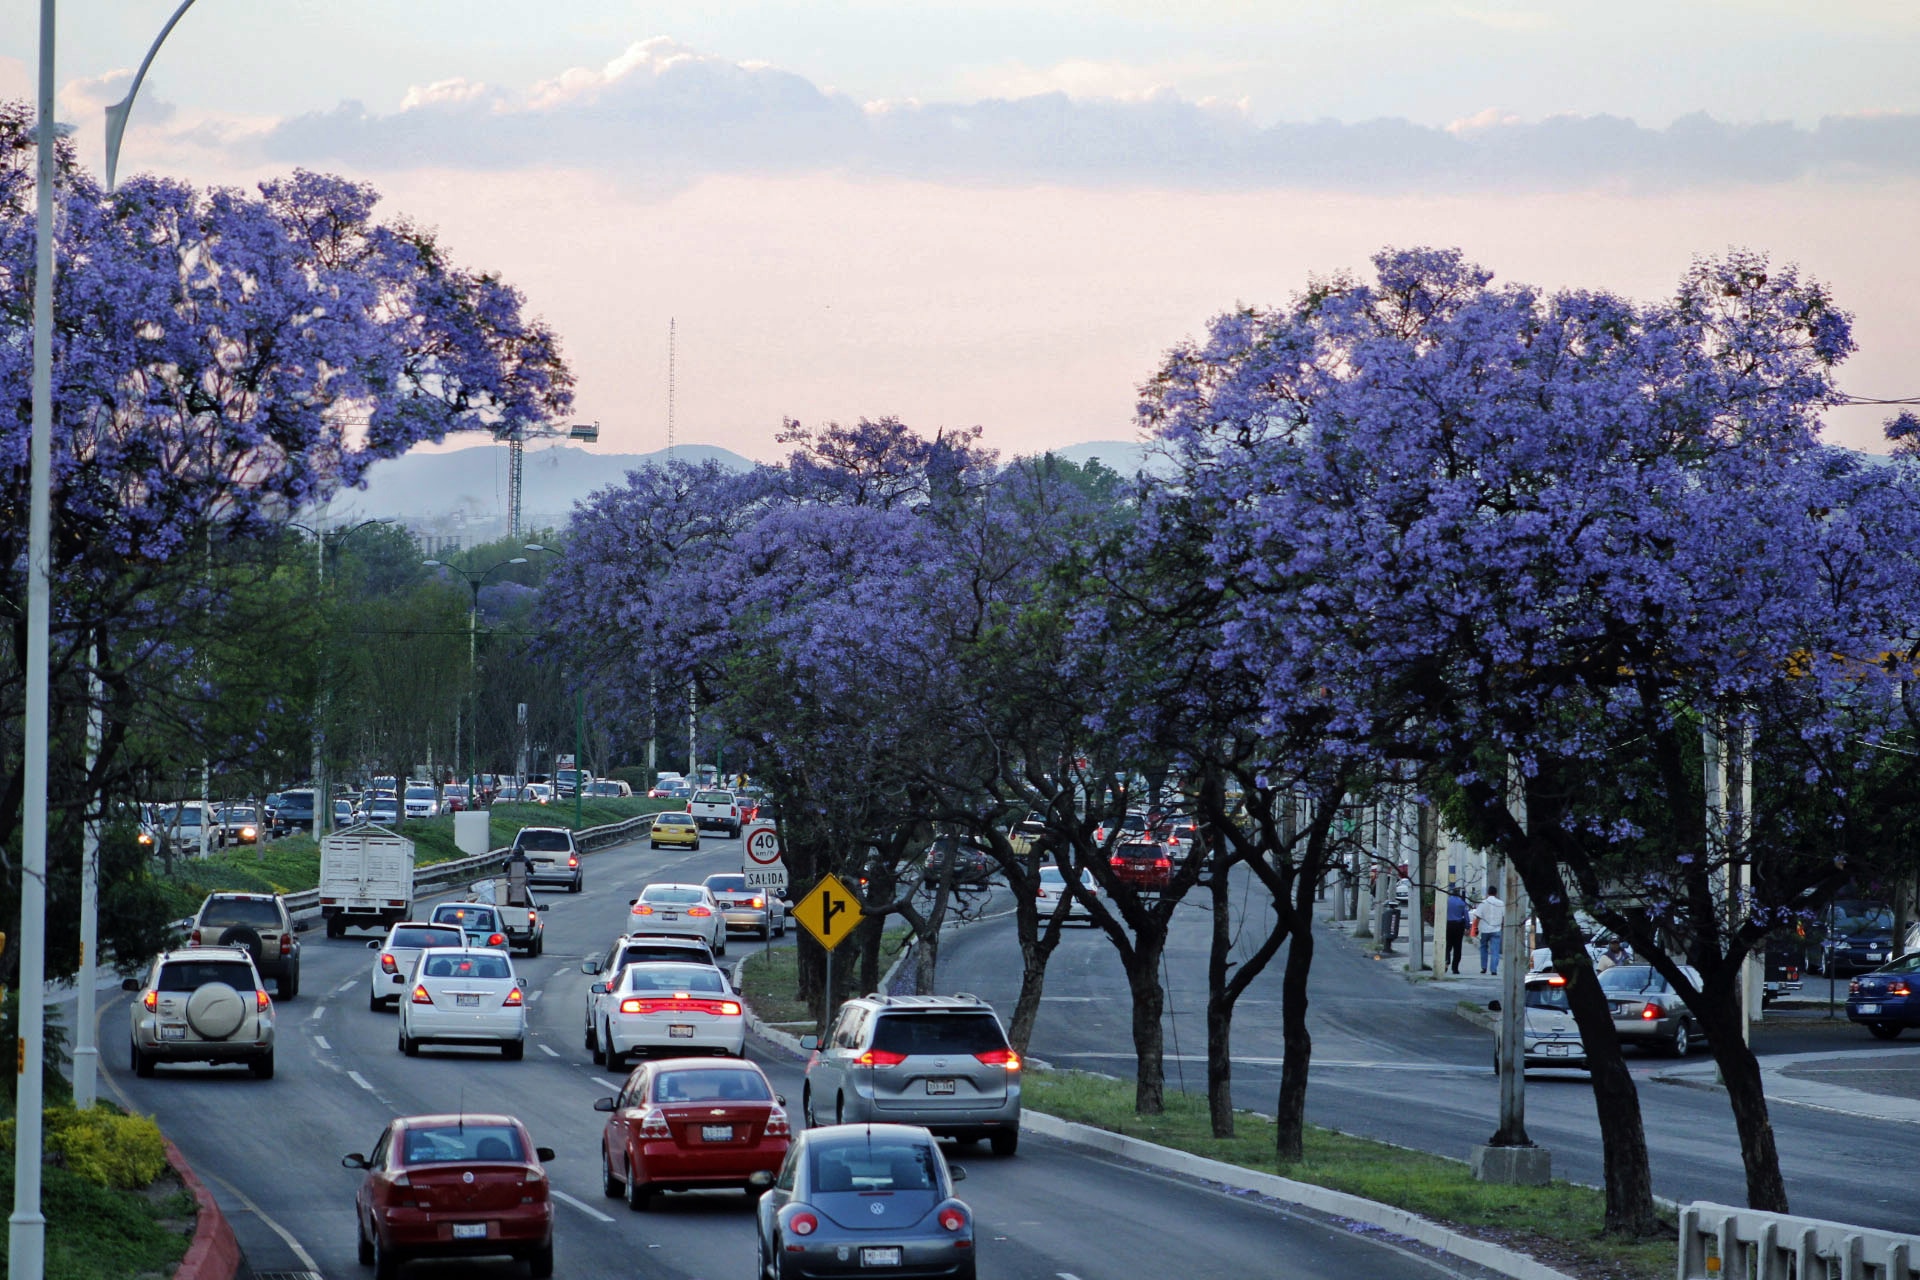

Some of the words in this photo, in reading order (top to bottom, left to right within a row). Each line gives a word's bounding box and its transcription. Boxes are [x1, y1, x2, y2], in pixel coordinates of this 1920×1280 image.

[756, 835, 774, 848] 40
[749, 873, 784, 885] SALIDA
[230, 940, 250, 950] Jeep
